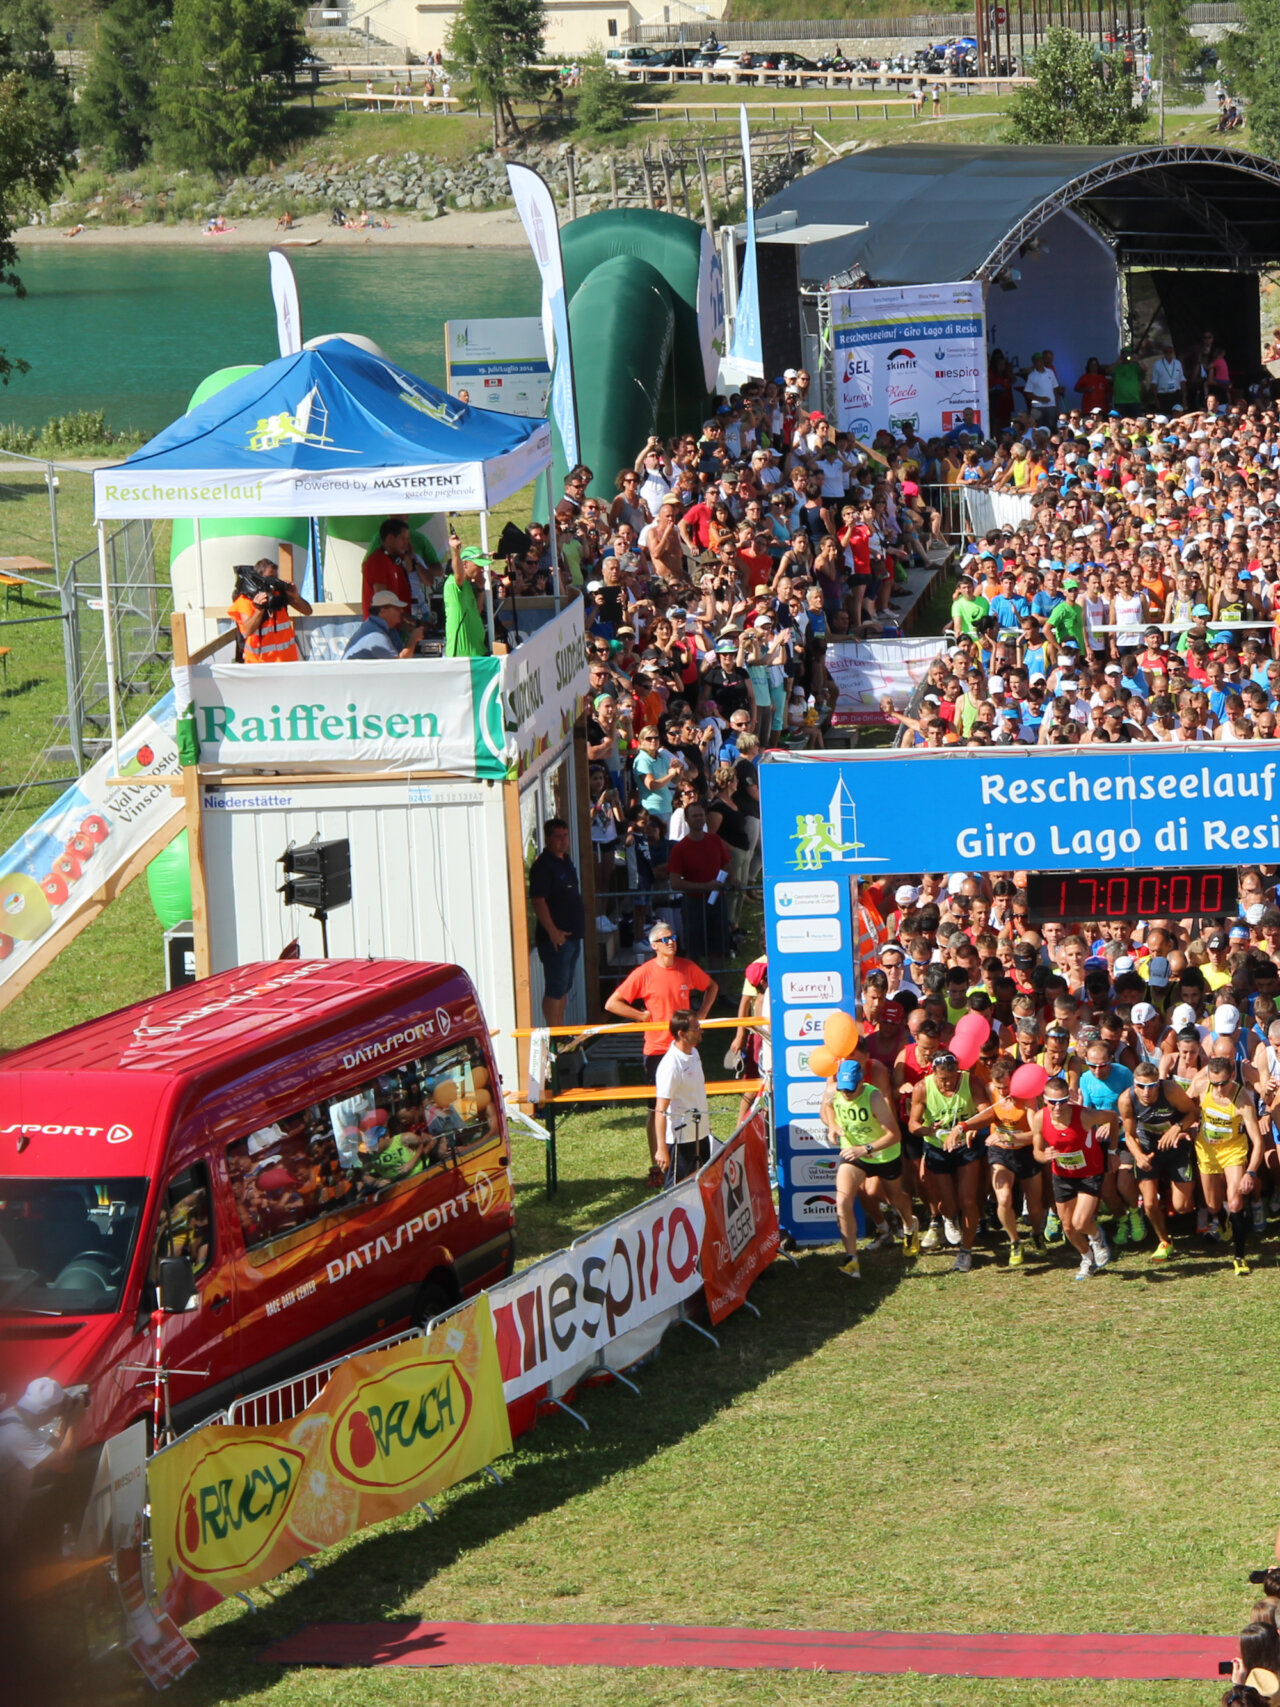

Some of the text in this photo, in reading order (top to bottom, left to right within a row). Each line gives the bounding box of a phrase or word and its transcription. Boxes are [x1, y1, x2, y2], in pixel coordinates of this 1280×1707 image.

[840, 323, 977, 344] Reschenseelauf Giro Lago di Resia
[849, 361, 870, 375] SEL
[886, 360, 918, 371] skinfit
[947, 368, 980, 379] espiro
[851, 423, 869, 433] mila
[105, 482, 263, 501] Reschenseelauf
[295, 475, 462, 492] Powered by MASTERTENT
[200, 703, 442, 743] Raiffeisen
[109, 750, 178, 813] Val Veosta
[980, 762, 1277, 805] Reschenseelauf
[204, 795, 293, 809] Niederstätter
[956, 823, 1036, 859] Giro
[1050, 825, 1141, 862] Lago
[1155, 817, 1188, 852] di
[1060, 874, 1223, 916] 17:00:00
[343, 1019, 435, 1069] DATASPORT
[803, 1203, 838, 1214] skinfit
[326, 1191, 470, 1285] DATASPORT
[265, 1280, 317, 1317] RACE DATA CENTER
[549, 1207, 699, 1352] espiro
[367, 1376, 456, 1460] RAUCH
[199, 1457, 292, 1545] RAUCH
